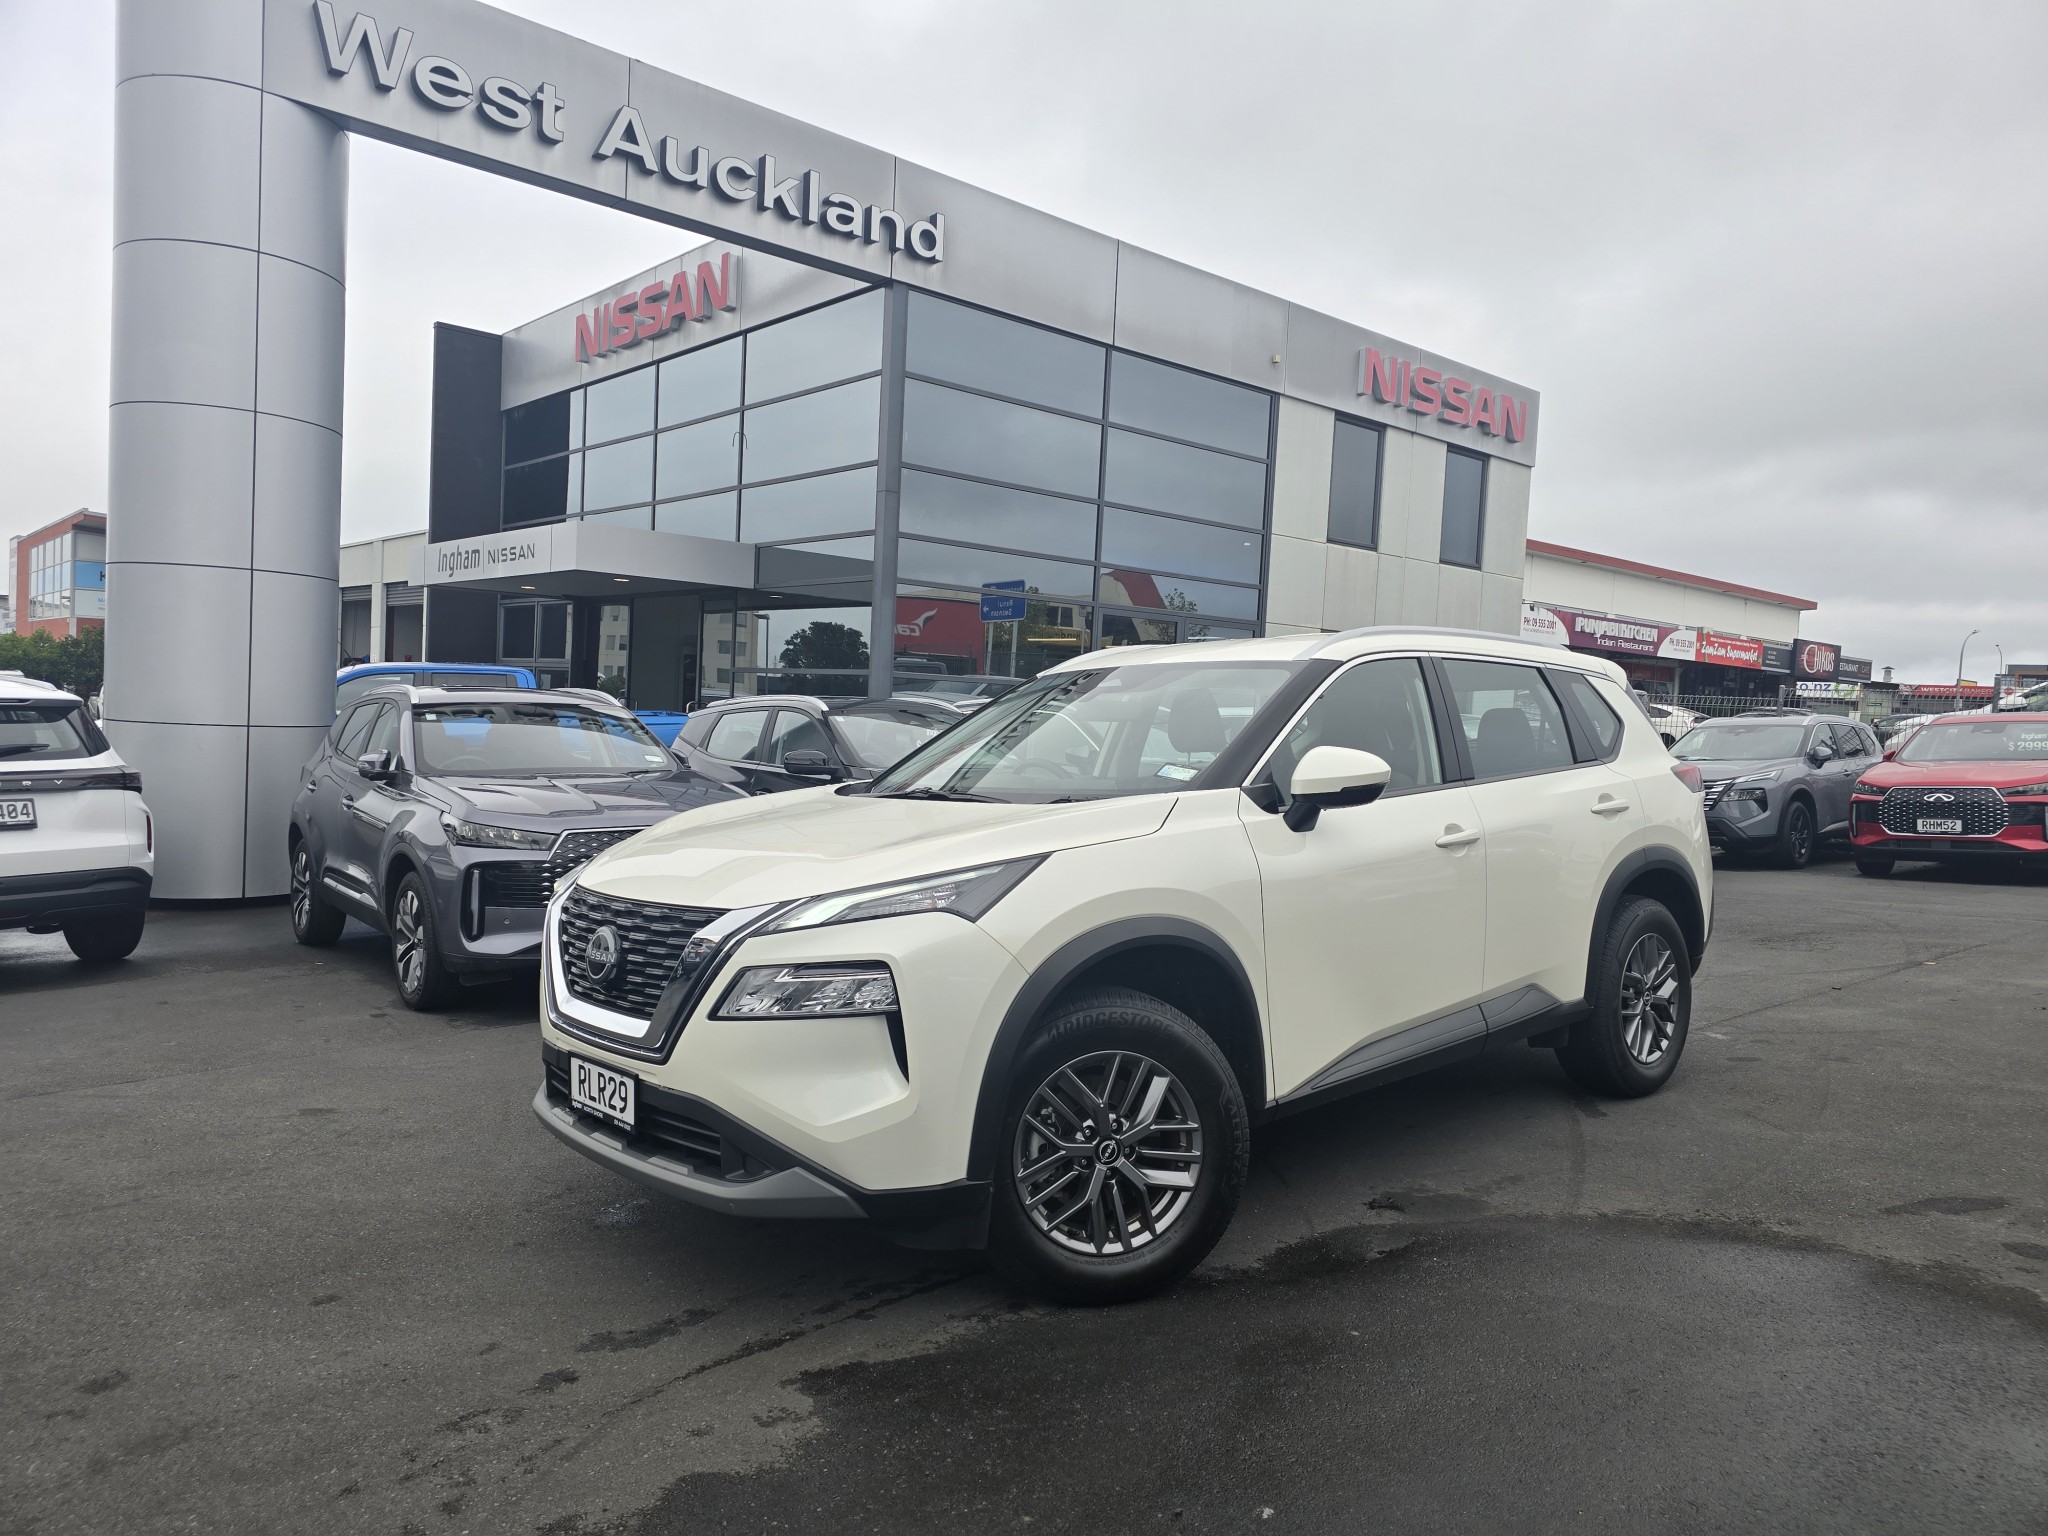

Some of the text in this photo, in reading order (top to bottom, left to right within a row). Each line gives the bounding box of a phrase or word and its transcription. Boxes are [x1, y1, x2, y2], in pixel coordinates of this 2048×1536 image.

[314, 0, 946, 264] West Auckland
[575, 252, 736, 363] NISSAN
[1358, 347, 1527, 443] NISSAN
[437, 542, 535, 578] Ingham NISSAN
[1531, 617, 1538, 627] 09
[1574, 616, 1620, 638] PUNJABI
[1619, 622, 1659, 643] KITCHEN
[1597, 636, 1654, 652] Indian Restaurant
[1727, 645, 1758, 663] Supermarket
[1839, 662, 1859, 672] ESTAURANT
[1796, 682, 1832, 692] o.nz
[2020, 732, 2047, 741] Ingham
[1921, 820, 1957, 831] RHM52
[1046, 1011, 1176, 1041] BRIDGESTONE
[578, 1064, 628, 1114] RLR29
[1228, 1104, 1243, 1185] ALENZA
